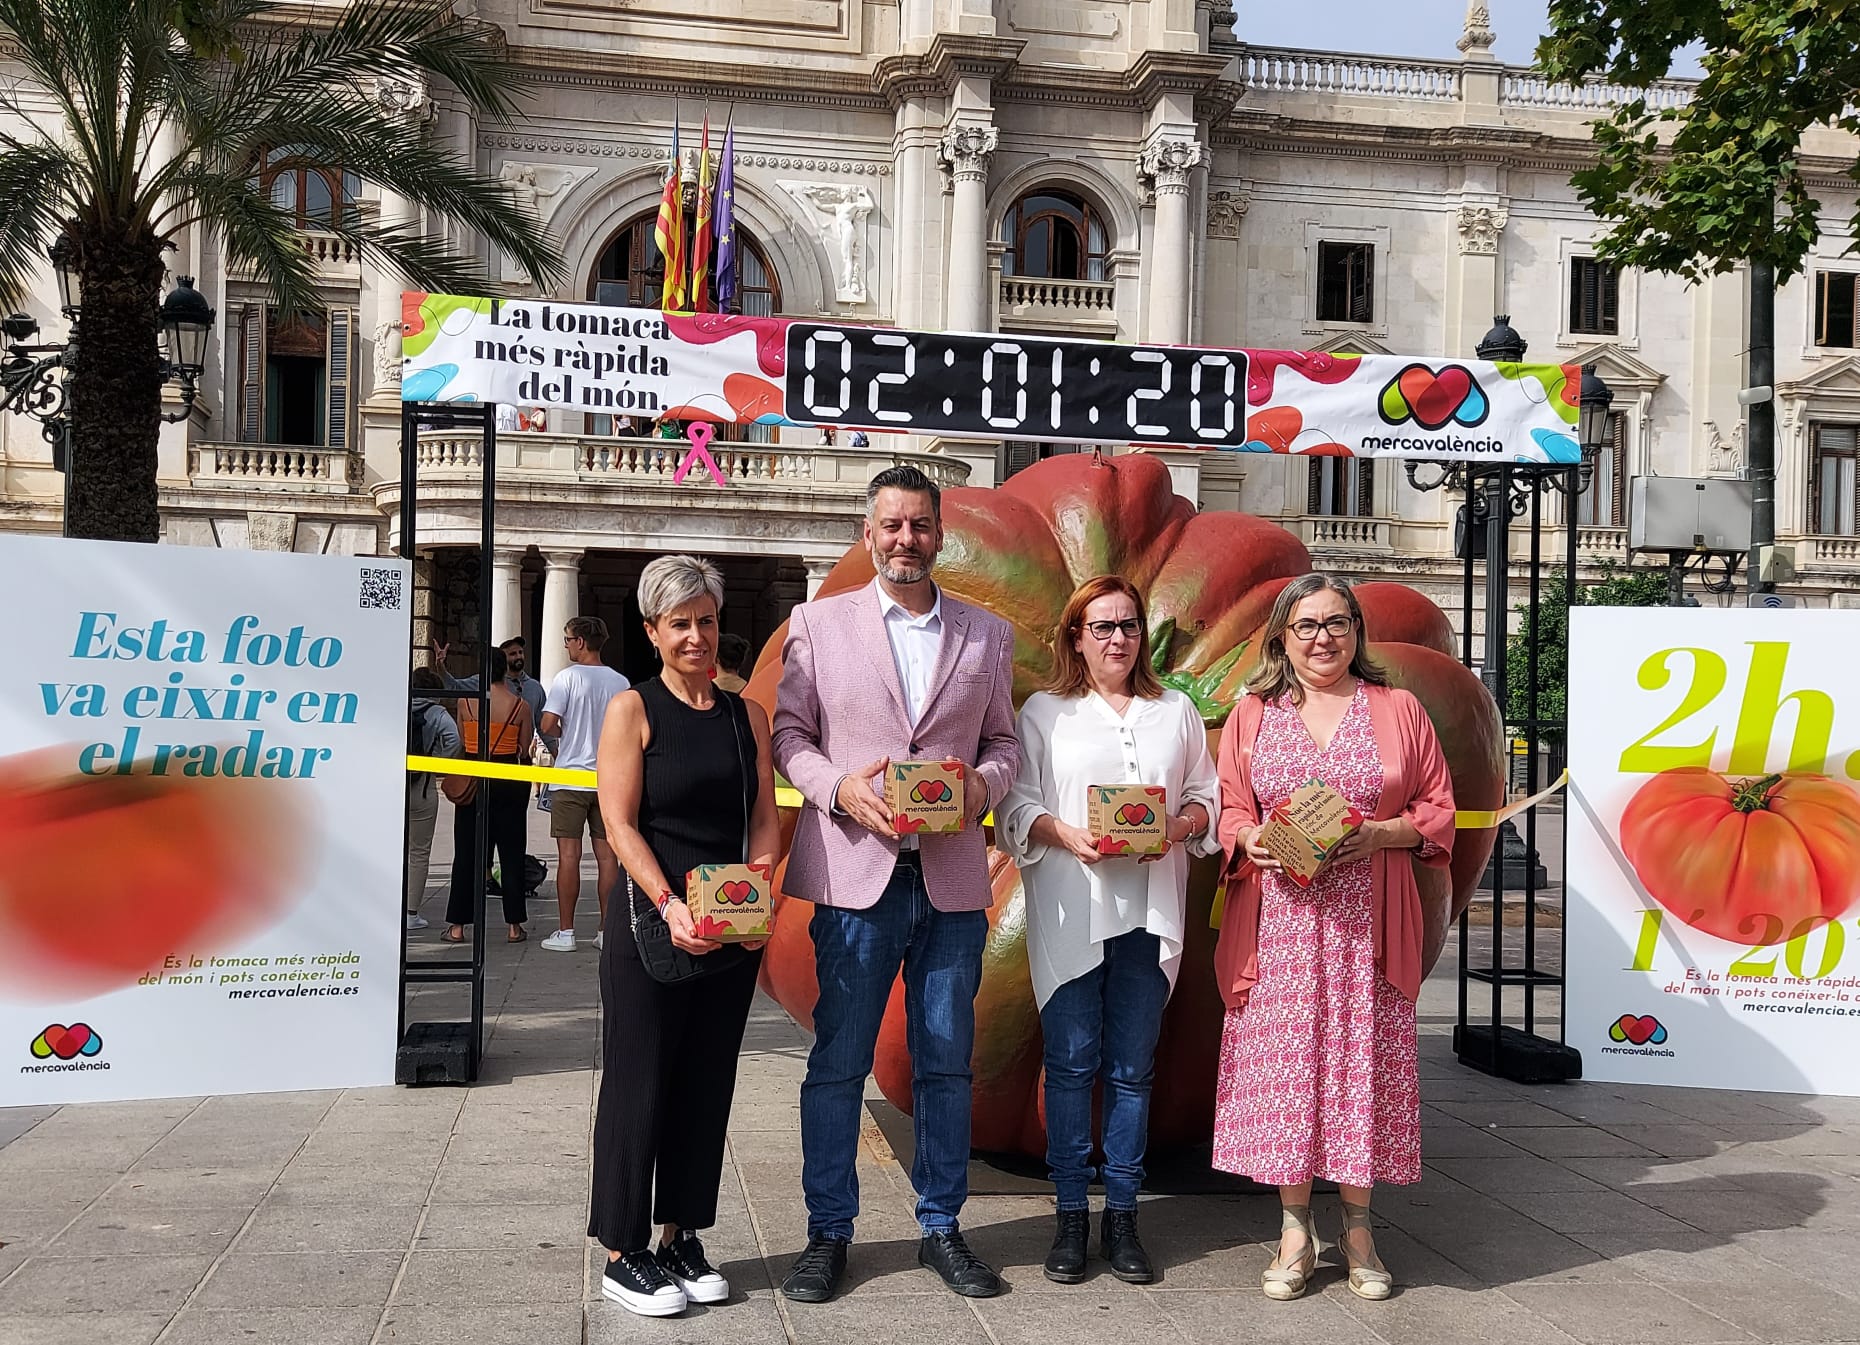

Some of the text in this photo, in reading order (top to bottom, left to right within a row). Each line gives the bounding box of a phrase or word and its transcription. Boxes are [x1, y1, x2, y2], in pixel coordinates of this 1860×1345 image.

[488, 299, 672, 340] La tomaca
[474, 335, 671, 380] més ràpida
[518, 371, 668, 411] del món.
[803, 330, 1235, 439] 02:01:20
[1361, 435, 1503, 453] mercavalència
[68, 611, 343, 669] Esta foto
[38, 672, 360, 724] va eixir en
[78, 726, 332, 779] el radar
[905, 804, 958, 813] mercavalència
[710, 906, 764, 914] mercavalència
[163, 950, 361, 969] És la tomaca més ràpida
[137, 966, 360, 986] del món i pots conéixer-la a
[1685, 966, 1702, 980] És
[1707, 969, 1720, 981] la
[1725, 972, 1778, 984] tomaca
[1783, 975, 1811, 986] més
[228, 984, 359, 1000] mercavalencia.es
[1663, 981, 1686, 994] del
[1690, 984, 1720, 995] món
[1725, 986, 1730, 996] i
[1734, 987, 1766, 999] pots
[1771, 989, 1849, 1001] conéixer-la
[1601, 1047, 1675, 1057] mercavalència
[20, 1060, 111, 1073] mercavalència
